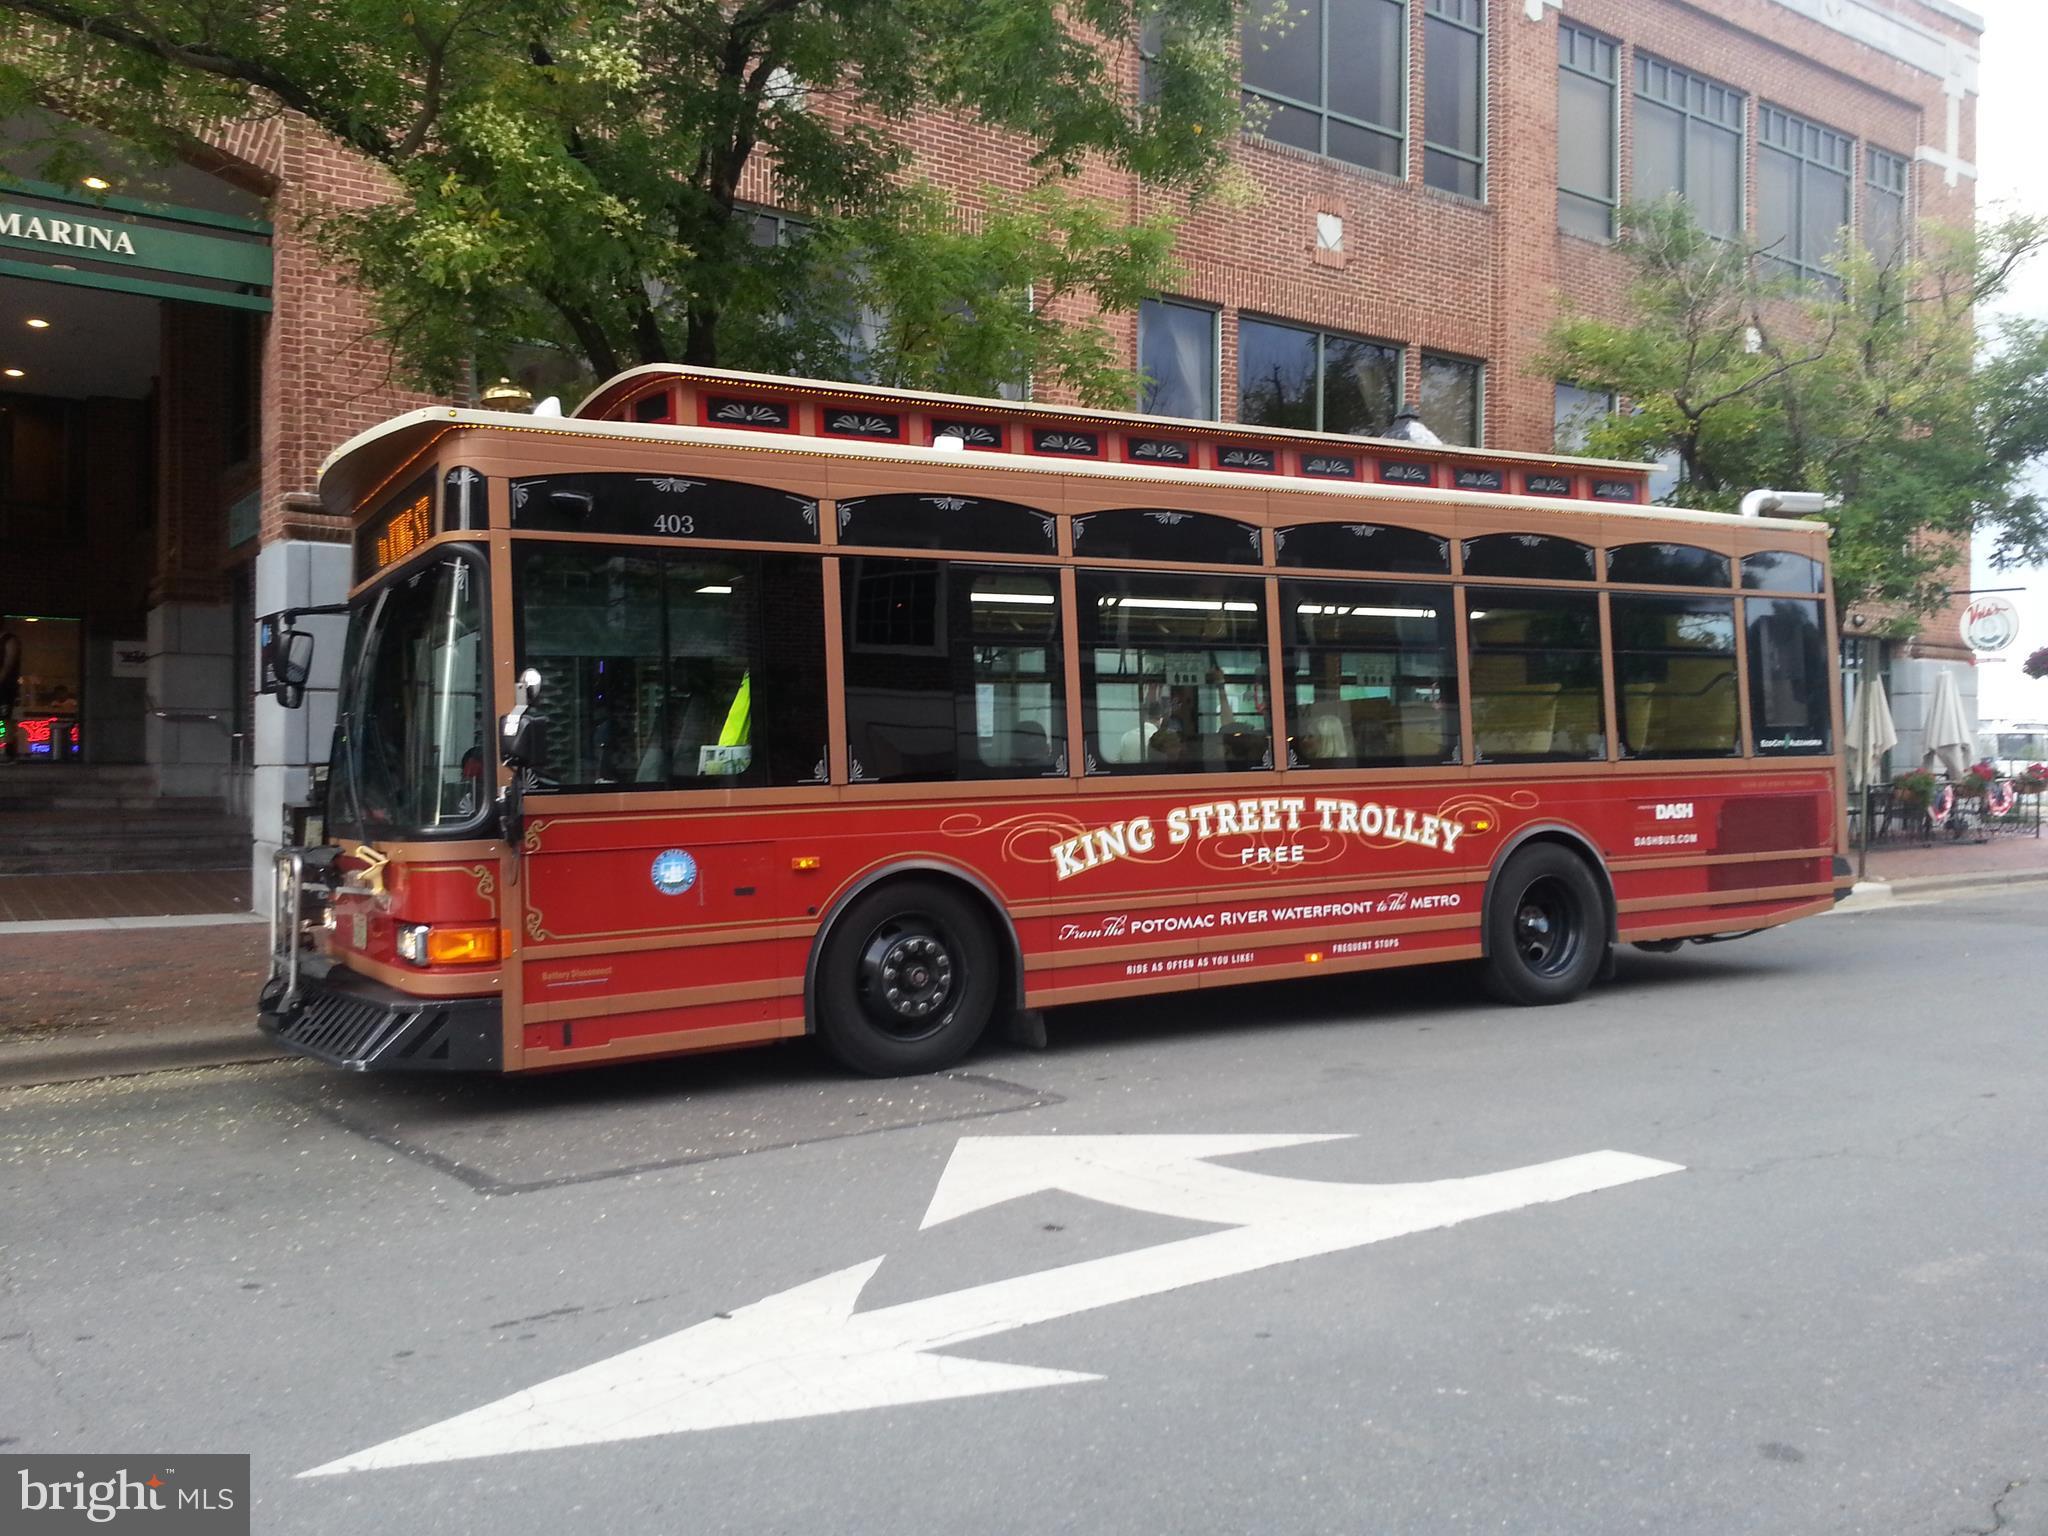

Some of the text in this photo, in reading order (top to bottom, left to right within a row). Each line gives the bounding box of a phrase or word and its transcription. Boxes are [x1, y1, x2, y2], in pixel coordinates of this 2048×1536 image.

[0, 213, 136, 255] MARINA
[654, 514, 695, 534] 403
[1655, 803, 1694, 820] DASH
[1050, 797, 1464, 880] KING STREET TROLLEY
[1633, 833, 1698, 847] DASHBUS.COM
[1241, 845, 1304, 864] FREE
[1058, 892, 1461, 941] From The POTOMAC RIVER WATERFRONT to The METRO
[1332, 938, 1399, 953] FREQUENT STOPS
[1126, 952, 1254, 975] RIDE AS OFTEN AS YOU LIKE!
